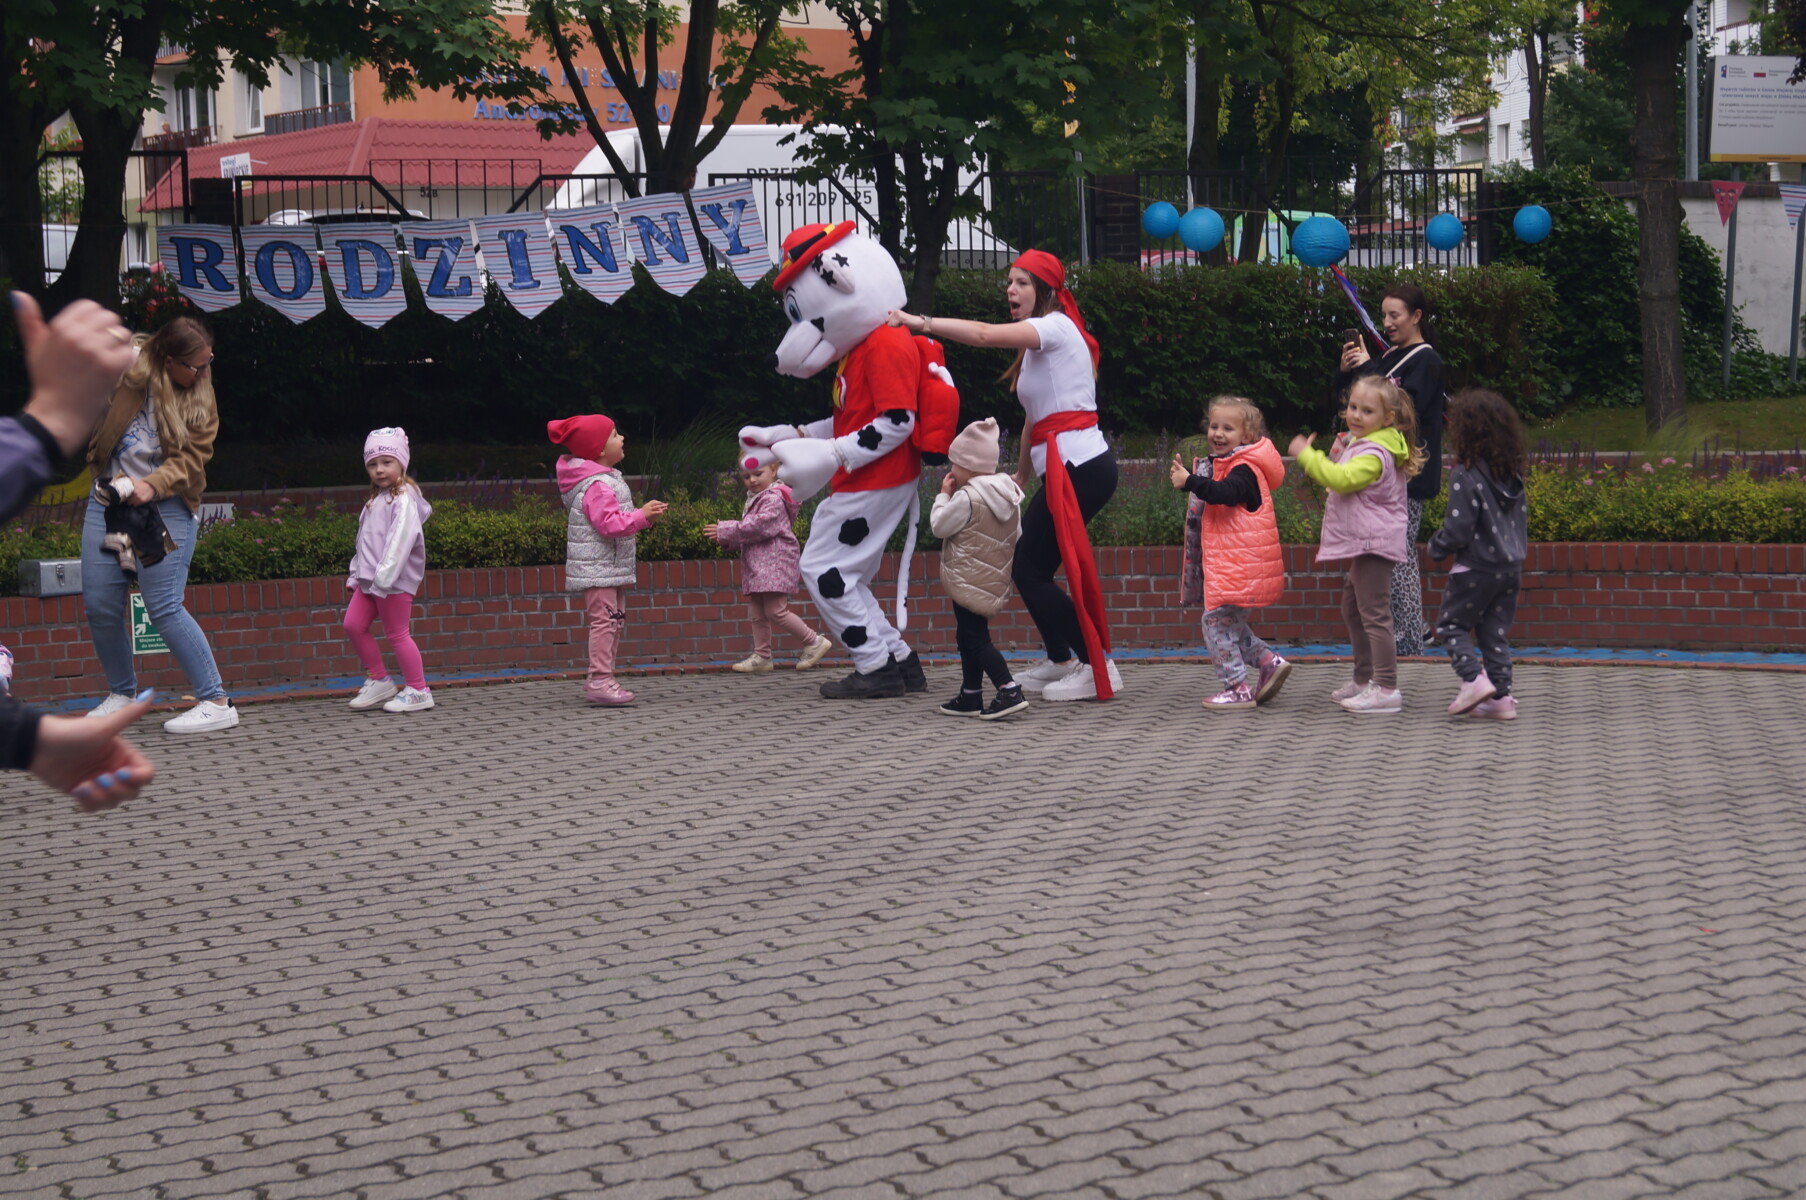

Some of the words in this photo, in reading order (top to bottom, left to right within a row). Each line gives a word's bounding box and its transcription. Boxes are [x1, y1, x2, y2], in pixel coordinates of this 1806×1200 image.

[775, 191, 803, 207] 691
[808, 190, 837, 207] 209
[169, 199, 750, 301] RODZINNY
